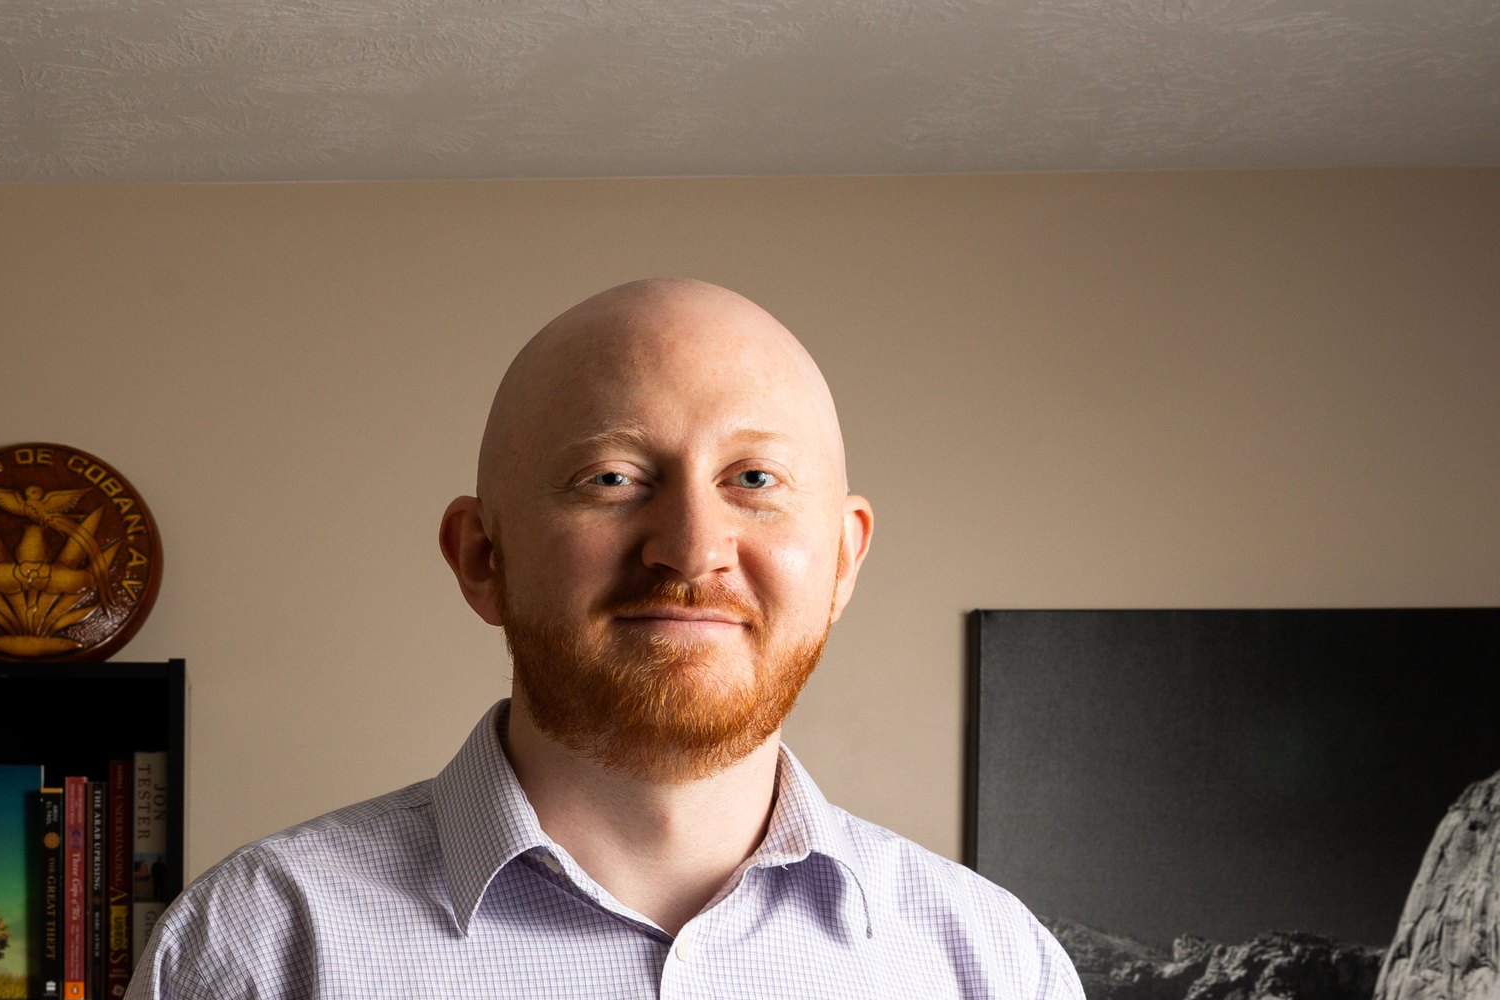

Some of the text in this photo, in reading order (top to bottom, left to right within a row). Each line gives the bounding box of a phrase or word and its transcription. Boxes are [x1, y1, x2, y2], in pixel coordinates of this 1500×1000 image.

[14, 447, 56, 467] DE
[137, 764, 151, 840] TESTER
[153, 783, 167, 822] JON
[92, 789, 102, 890] THE ARAB UPRISING
[114, 795, 125, 886] UNDERSTANDING
[71, 851, 81, 876] Three
[69, 878, 82, 898] Cups
[45, 857, 56, 961] THE GREAT THEFT
[71, 904, 81, 921] Tea
[114, 916, 124, 946] USED
